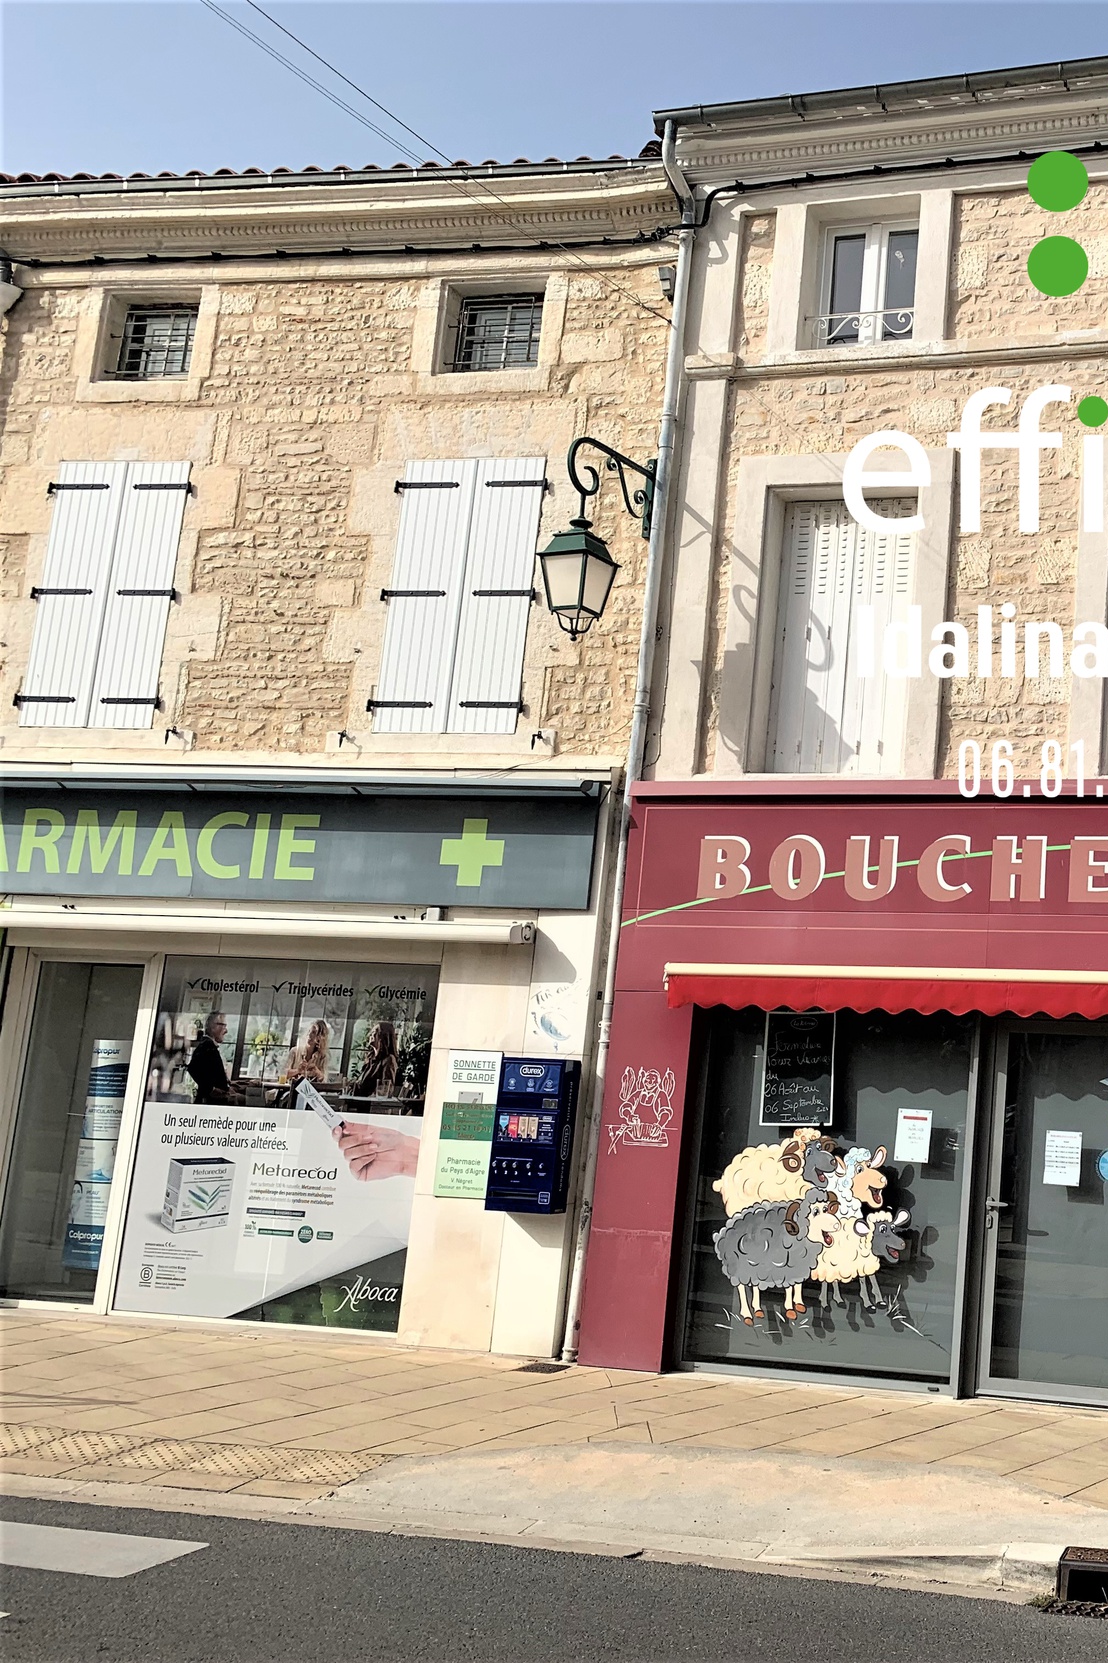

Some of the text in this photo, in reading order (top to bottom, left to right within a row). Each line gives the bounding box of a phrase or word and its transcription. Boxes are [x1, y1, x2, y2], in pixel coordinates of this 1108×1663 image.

[0, 807, 321, 881] RMACIE
[200, 978, 260, 993] Cholestérol
[288, 981, 354, 998] Triglycérides
[378, 985, 427, 1000] Glycémie
[453, 1059, 497, 1070] SONNETTE
[522, 1066, 541, 1075] durex
[452, 1072, 495, 1082] DE GARDE
[164, 1113, 276, 1132] Un seul remède pour une
[161, 1132, 289, 1151] ou plusieurs valeurs altérées.
[447, 1157, 481, 1166] Pharmacie
[252, 1162, 338, 1180] Metarecod
[333, 1274, 398, 1312] Aboca
